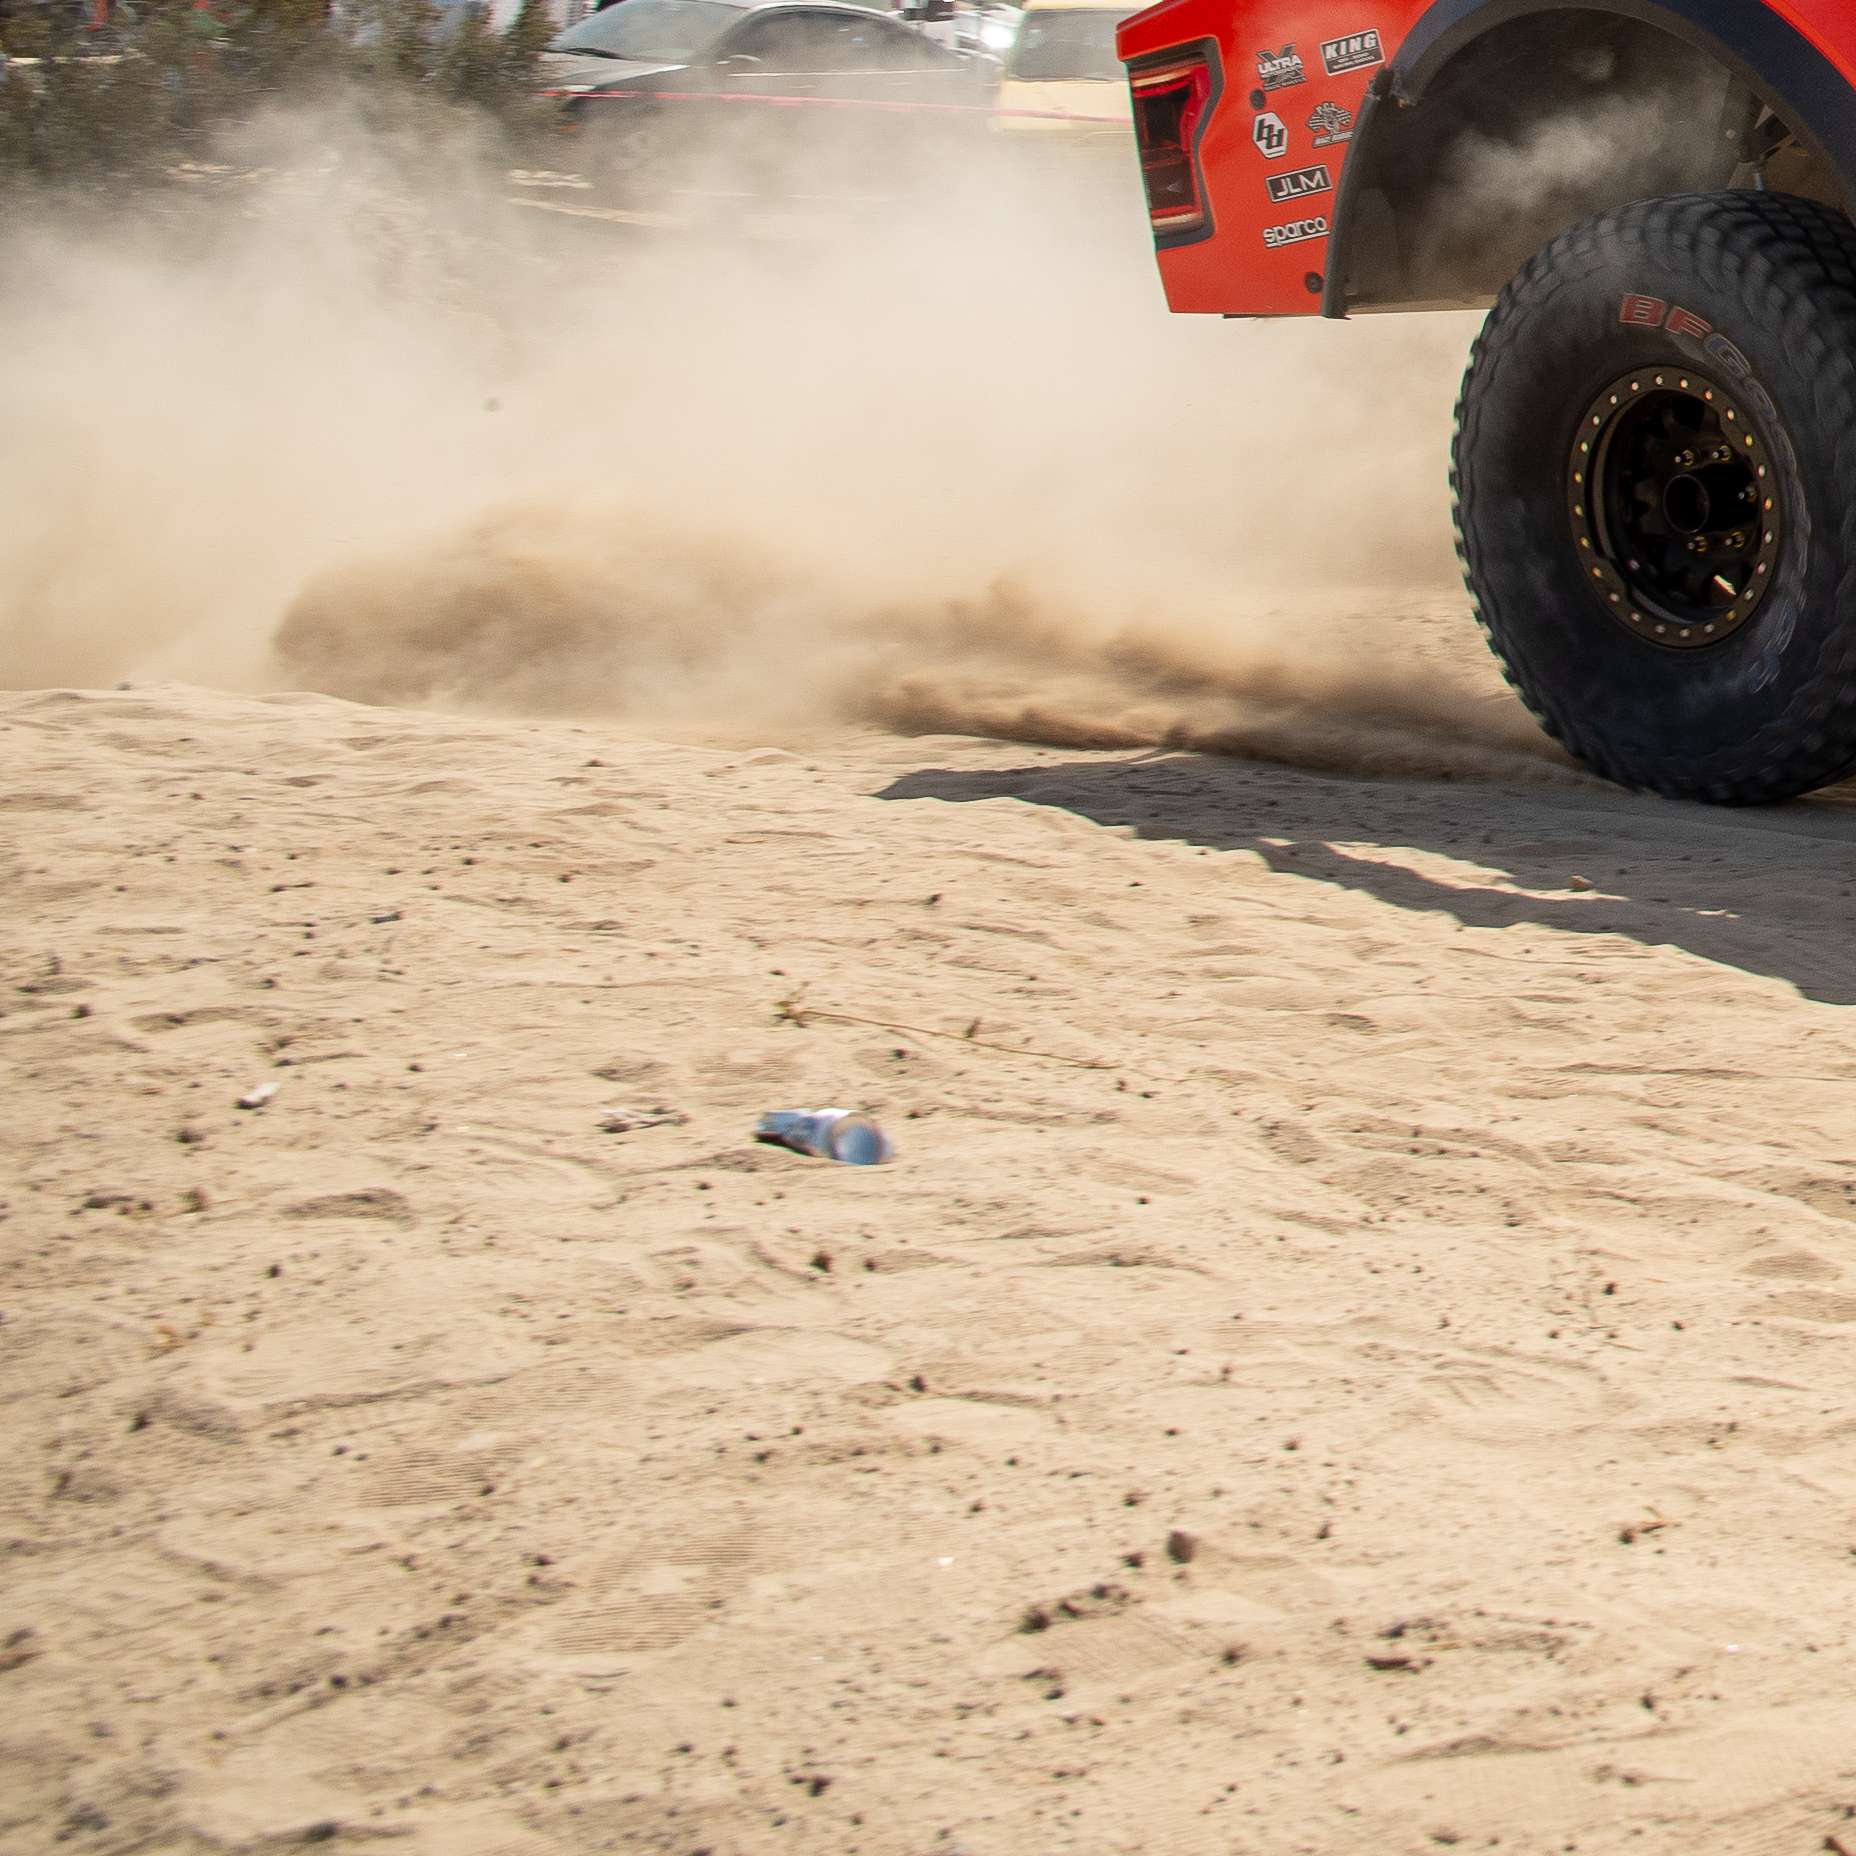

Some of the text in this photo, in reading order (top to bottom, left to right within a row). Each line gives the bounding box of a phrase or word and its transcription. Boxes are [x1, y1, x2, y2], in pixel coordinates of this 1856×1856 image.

[1325, 32, 1377, 59] KING
[1257, 54, 1303, 74] ULTRA
[1276, 170, 1326, 196] JLM
[1263, 216, 1328, 245] sparco
